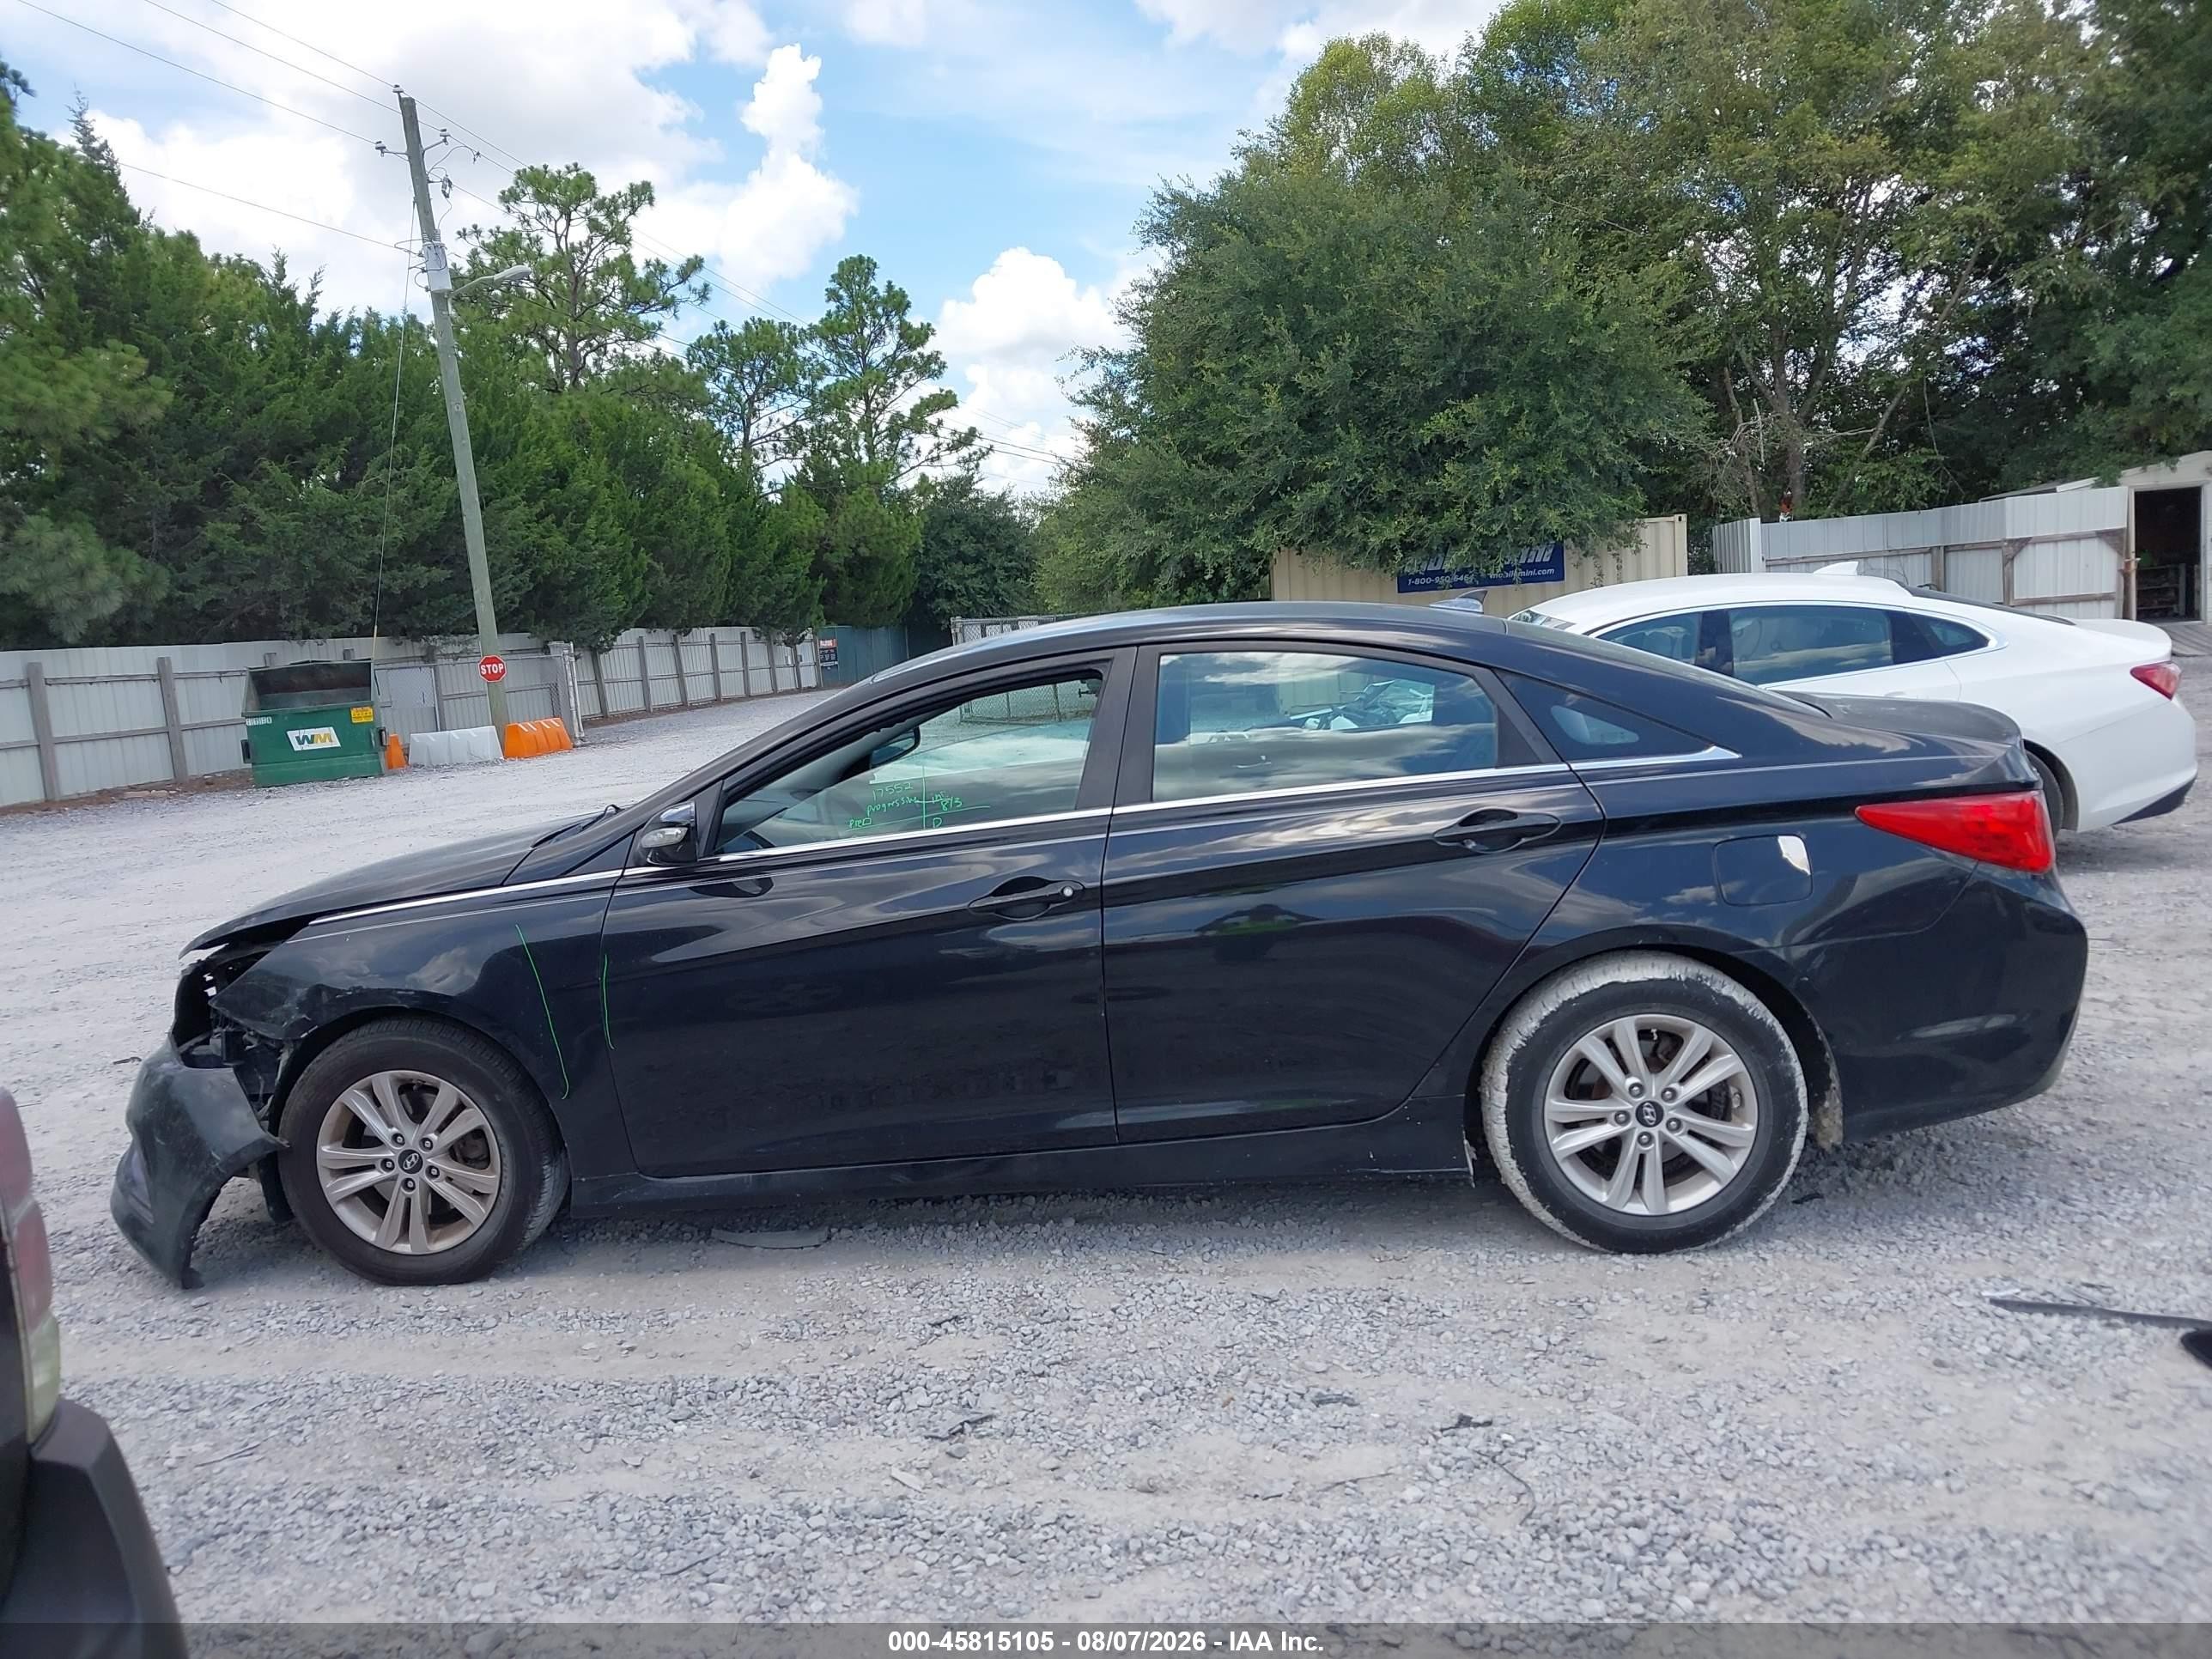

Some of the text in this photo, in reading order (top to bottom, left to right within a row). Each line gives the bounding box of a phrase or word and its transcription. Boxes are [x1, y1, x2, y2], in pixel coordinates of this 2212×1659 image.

[1408, 568, 1555, 586] 1-800-9506464 mobilmini.com
[481, 663, 504, 675] STOP
[295, 732, 333, 745] WM
[872, 782, 914, 801] 17552
